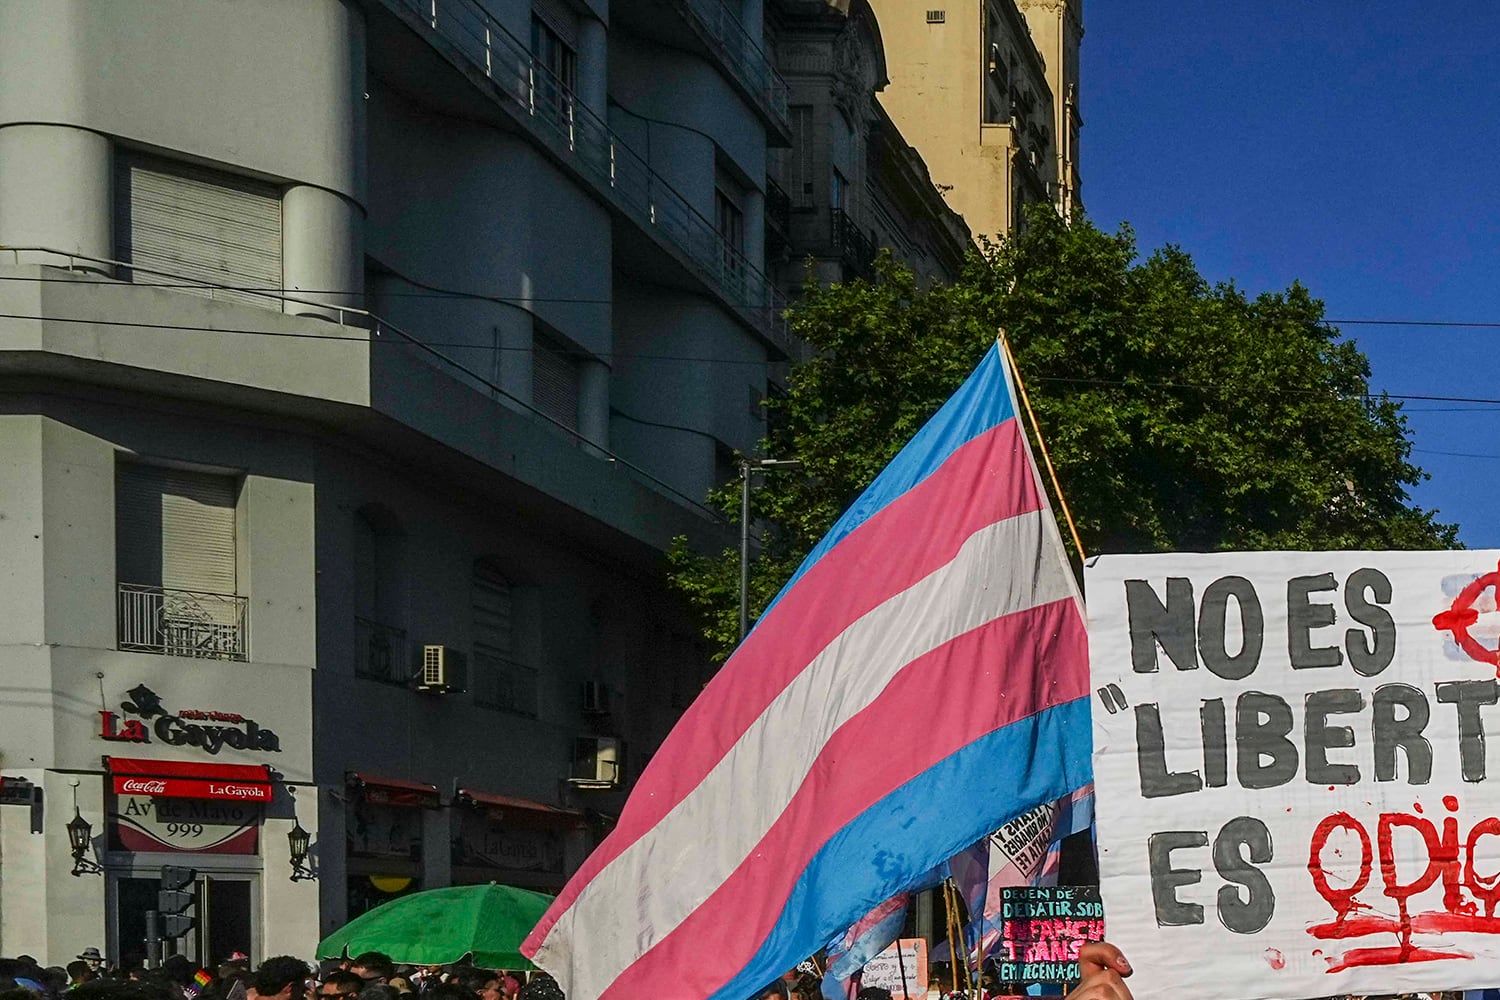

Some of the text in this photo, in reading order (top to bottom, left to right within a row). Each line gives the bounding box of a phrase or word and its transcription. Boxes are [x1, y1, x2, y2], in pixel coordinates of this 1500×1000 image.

[1125, 568, 1396, 680] NO ES
[98, 711, 145, 738] La
[154, 715, 282, 755] Gayola
[210, 785, 265, 798] La Gayola
[167, 822, 203, 838] 999
[1149, 816, 1275, 934] ES
[1003, 889, 1075, 900] DEJEN DE
